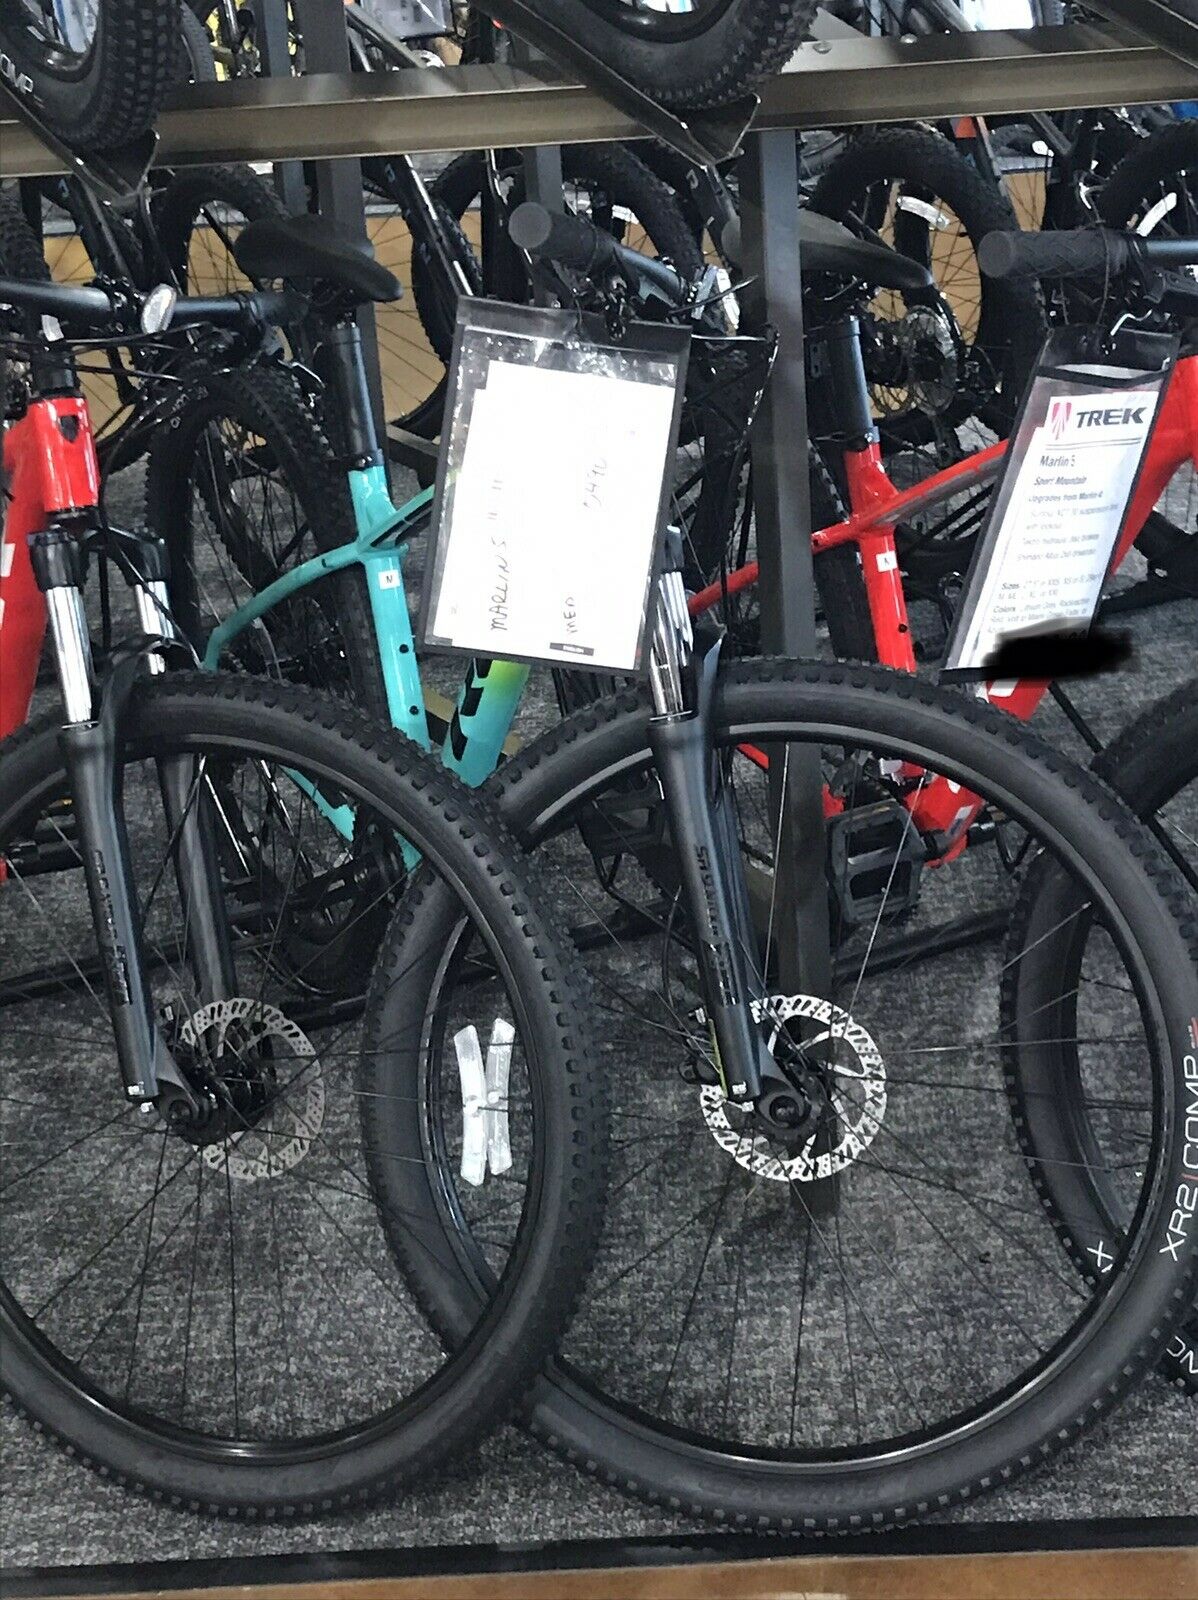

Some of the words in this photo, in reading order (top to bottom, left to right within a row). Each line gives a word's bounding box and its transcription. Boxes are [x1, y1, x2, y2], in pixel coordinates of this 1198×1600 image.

[1076, 407, 1147, 429] TREK
[1040, 455, 1069, 467] Marlin
[489, 554, 509, 631] MARLIN
